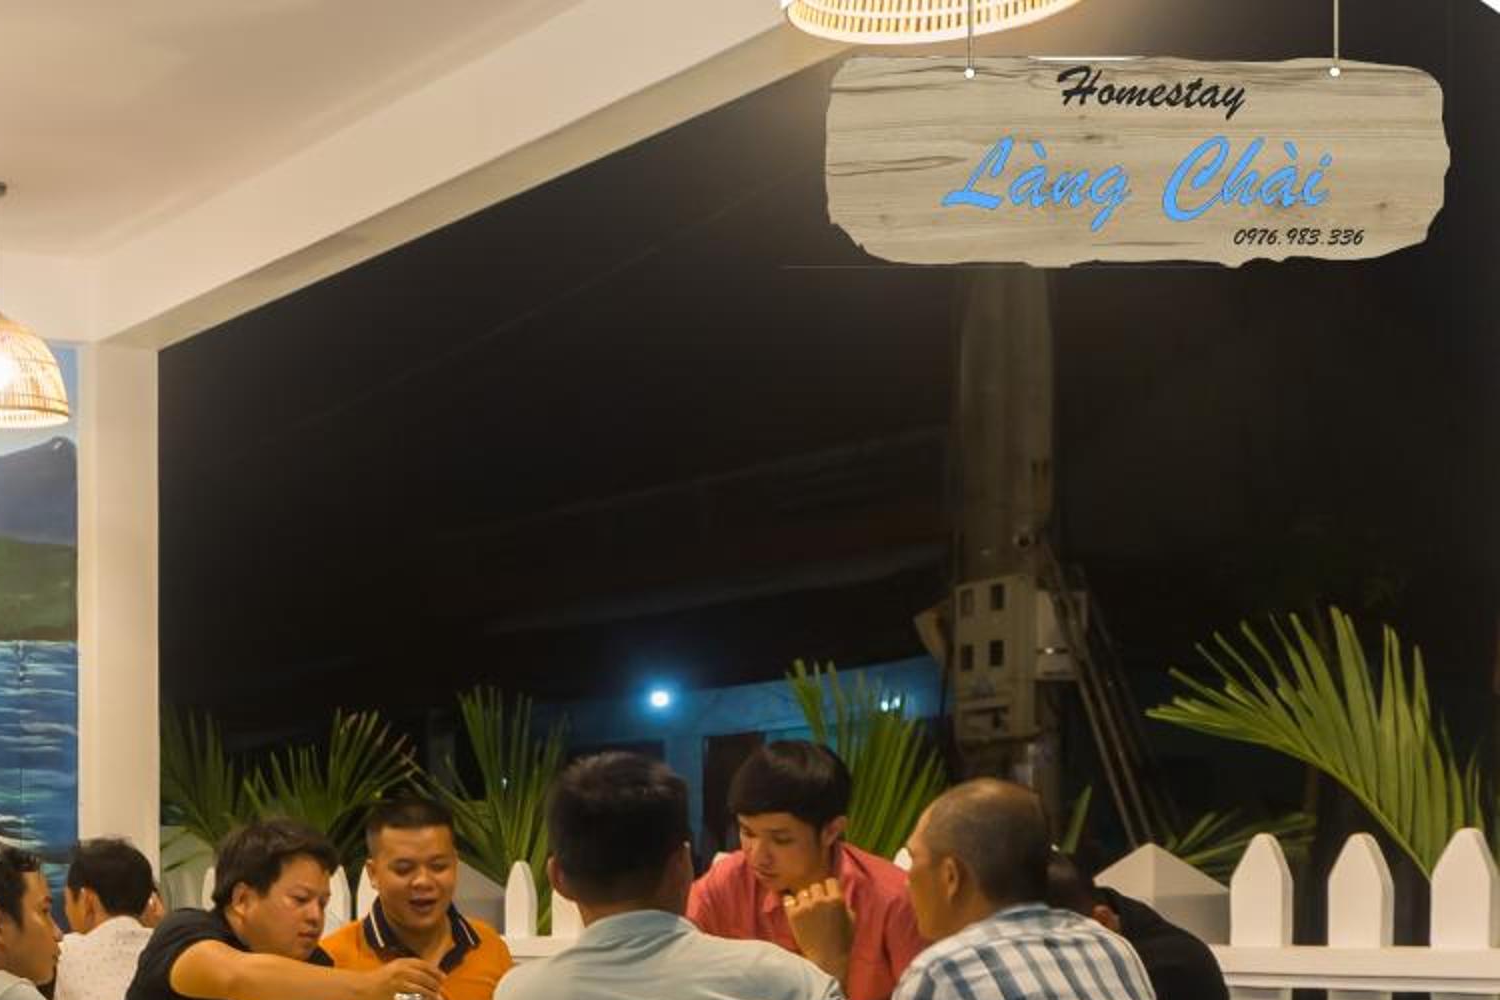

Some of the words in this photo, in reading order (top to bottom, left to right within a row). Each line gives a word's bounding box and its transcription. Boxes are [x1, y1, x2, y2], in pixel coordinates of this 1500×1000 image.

[1057, 65, 1246, 120] Homestay
[941, 136, 1129, 233] Làng
[1162, 133, 1333, 222] Chài
[1233, 227, 1364, 247] 0976.983.336
